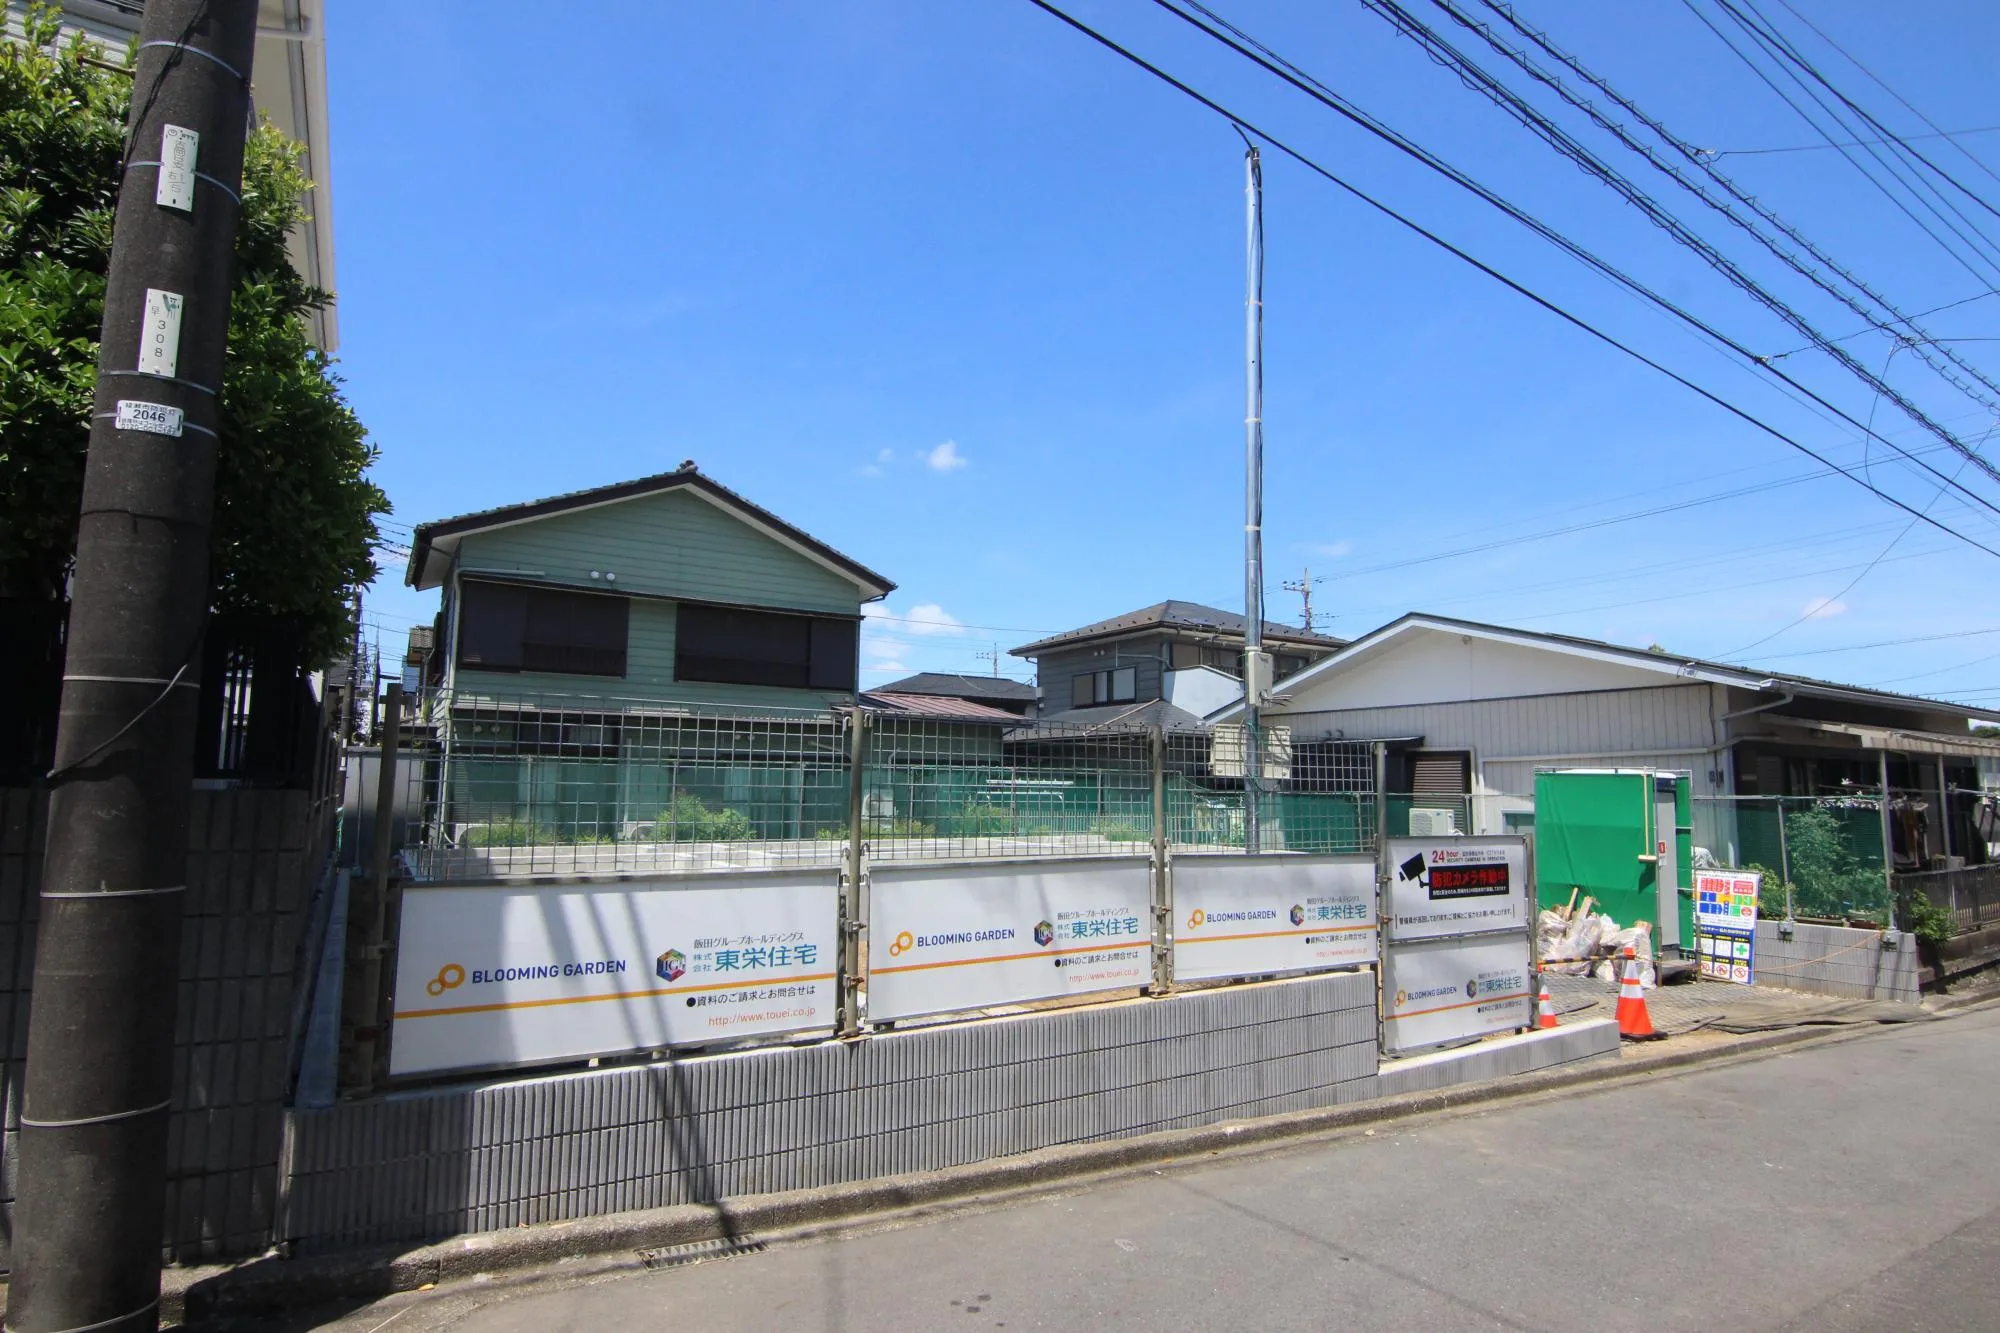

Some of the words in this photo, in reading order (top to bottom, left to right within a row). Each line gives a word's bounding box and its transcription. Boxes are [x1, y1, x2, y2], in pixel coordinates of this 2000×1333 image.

[155, 320, 167, 358] 308
[133, 409, 166, 423] 2046
[1432, 850, 1445, 864] 24
[1432, 870, 1506, 888] 防犯カメラ作動中
[1206, 911, 1246, 923] BLOOMING
[1247, 909, 1277, 921] GARDEN
[1317, 904, 1368, 921] 東栄住宅
[917, 932, 972, 947] BLOOMING
[974, 928, 1015, 942] GARDEN
[1071, 917, 1139, 940] 東栄住宅
[693, 932, 805, 949] 飯田グループホールディングス
[715, 943, 818, 973] 東栄住宅
[472, 964, 560, 984] BLOOMING
[563, 960, 627, 977] GARDEN
[1485, 976, 1522, 992] 東栄住宅
[696, 985, 816, 1007] 資料のご請求とお問合せは
[1408, 989, 1436, 1001] BLOOMING
[1436, 987, 1458, 997] GARDEN
[708, 1005, 816, 1028] http://www.touei.co.jp
